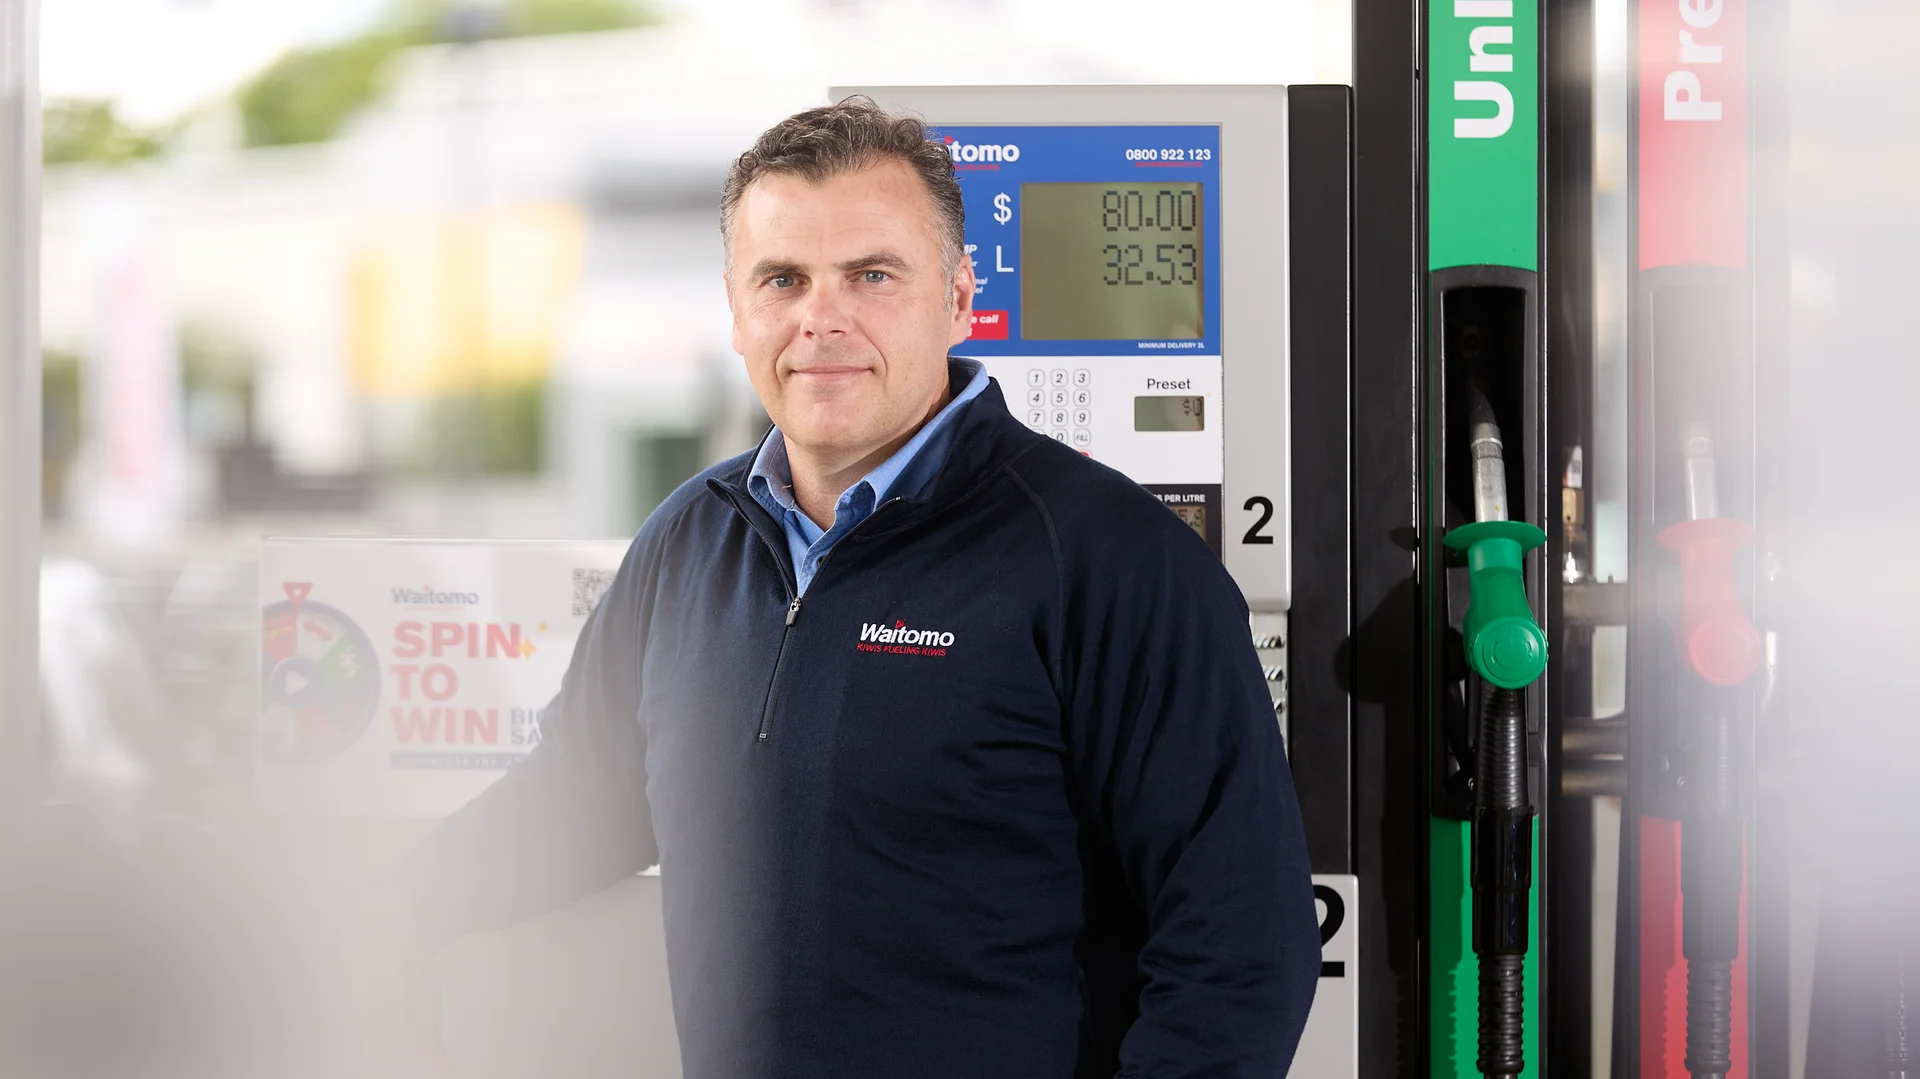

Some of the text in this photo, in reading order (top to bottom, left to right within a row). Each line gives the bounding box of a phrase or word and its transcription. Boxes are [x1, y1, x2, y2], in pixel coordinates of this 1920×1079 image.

[1664, 0, 1722, 121] Pre
[950, 140, 1021, 163] tomo
[1125, 149, 1212, 161] 0800 922 123
[993, 192, 1013, 225] $
[1103, 190, 1197, 231] 80.00
[996, 244, 1015, 273] L
[1103, 244, 1197, 285] 32.53
[979, 314, 999, 324] call
[1033, 374, 1086, 383] 1 2 3
[1147, 378, 1191, 390] Preset
[1033, 393, 1086, 403] 4 5 6
[1033, 413, 1086, 422] 7 8 9
[1164, 494, 1181, 503] PER
[1182, 494, 1206, 503] LITRE
[1242, 496, 1273, 544] 2
[391, 587, 480, 605] Waitomo
[392, 620, 522, 658] SPIN
[860, 621, 955, 647] Waitomo
[856, 642, 947, 657] KIWIS FUELING KIWIS
[390, 663, 459, 701] TO
[390, 708, 499, 745] WIN
